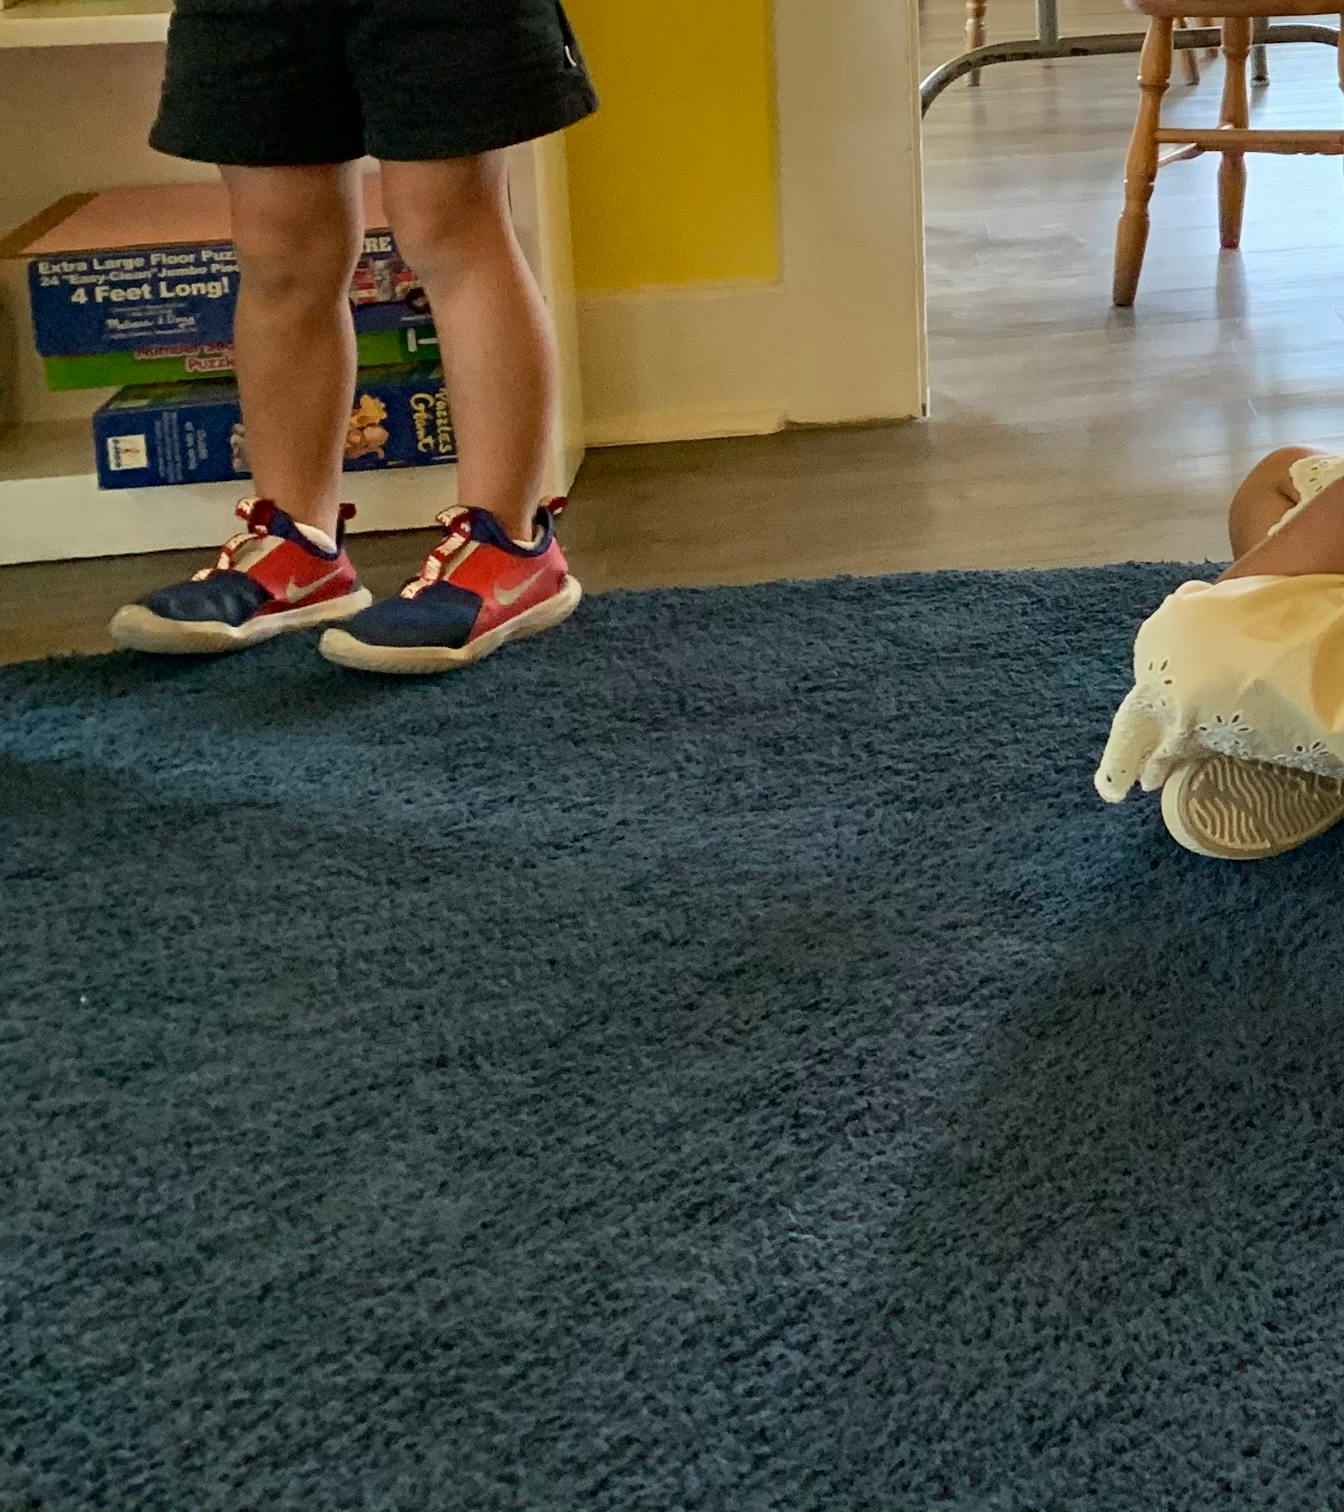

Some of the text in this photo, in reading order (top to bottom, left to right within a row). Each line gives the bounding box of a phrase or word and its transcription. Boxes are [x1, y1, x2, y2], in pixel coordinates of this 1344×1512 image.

[364, 237, 392, 253] RE
[38, 261, 87, 275] Extra
[92, 255, 145, 271] Large
[150, 252, 196, 266] Floor
[39, 275, 60, 286] 24
[159, 266, 208, 278] Jumbo
[70, 276, 230, 304] 4 Feet Long!
